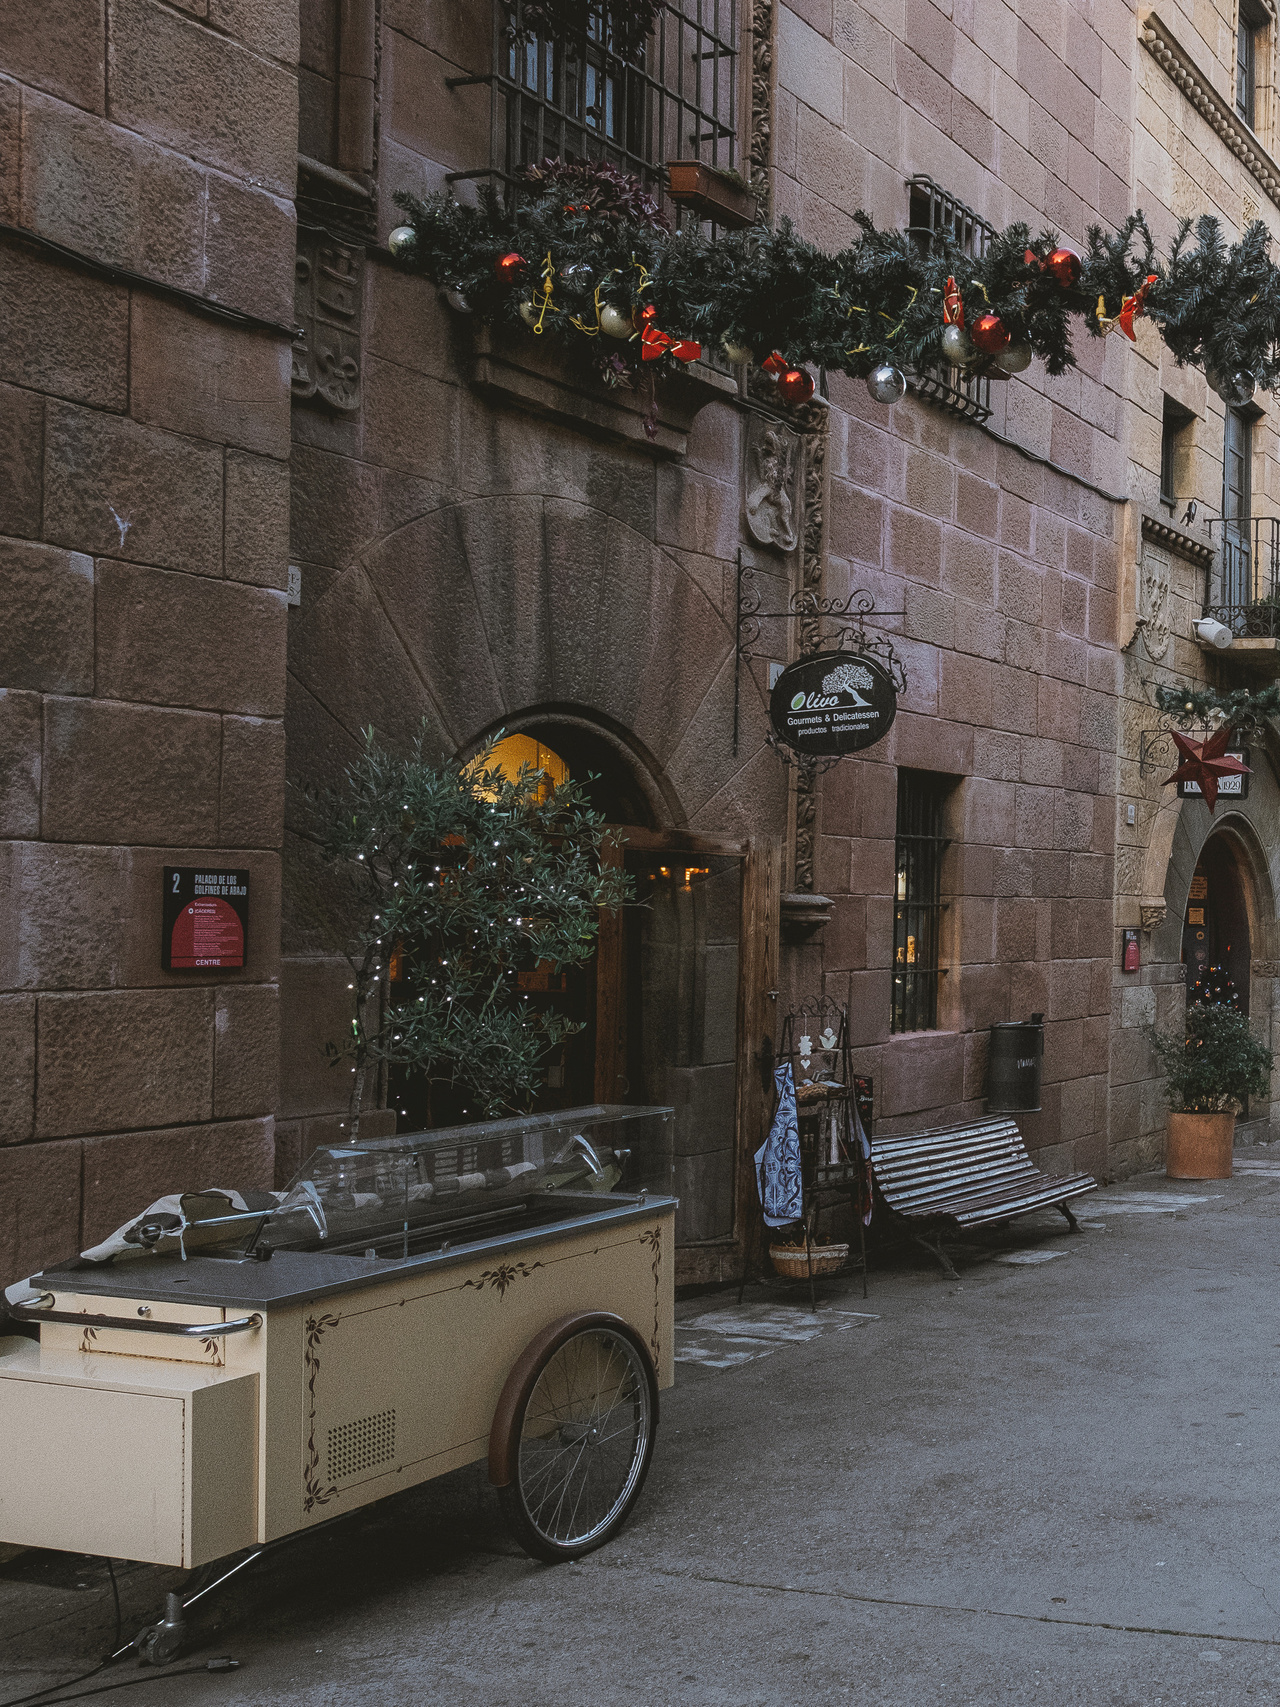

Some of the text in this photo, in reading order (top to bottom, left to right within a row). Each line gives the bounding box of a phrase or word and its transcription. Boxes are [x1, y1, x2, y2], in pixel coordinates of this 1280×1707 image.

[790, 691, 840, 711] Olivo
[787, 711, 880, 726] Gourmets & Delicatessen
[798, 722, 870, 737] productos tradicionales
[1223, 780, 1241, 791] 1929
[172, 872, 181, 893] 2
[194, 874, 237, 885] PALACIO DE LOS
[194, 885, 247, 896] GOLFINES DE ABAJO
